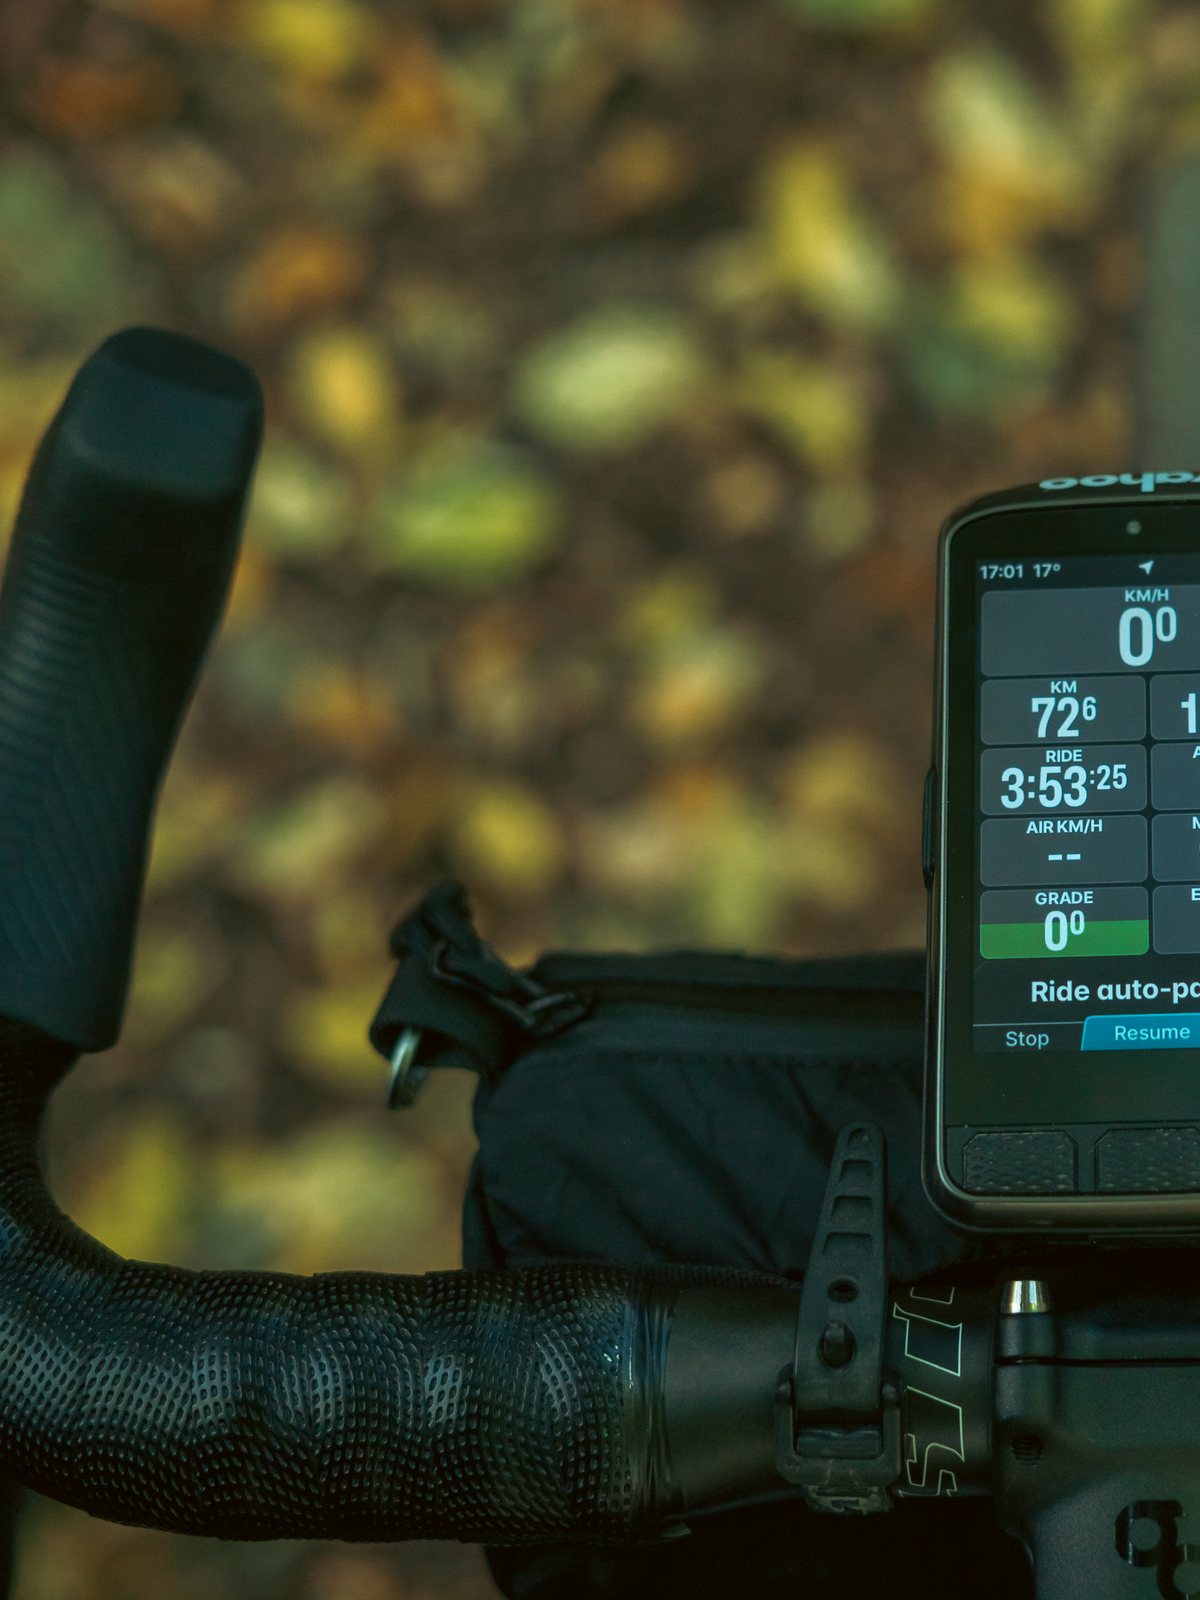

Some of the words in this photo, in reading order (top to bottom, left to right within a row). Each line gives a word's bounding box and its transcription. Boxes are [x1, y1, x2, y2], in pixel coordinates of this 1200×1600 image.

[981, 565, 1022, 579] 17:01
[1125, 589, 1168, 602] KM/H
[1051, 681, 1076, 693] KM
[1046, 750, 1082, 762] RIDE
[1026, 821, 1053, 833] AIR
[1057, 819, 1102, 833] KM/H
[1035, 891, 1093, 905] GRADE
[1032, 980, 1089, 1002] Ride
[1006, 1031, 1049, 1049] Stop
[1115, 1026, 1190, 1040] Resume
